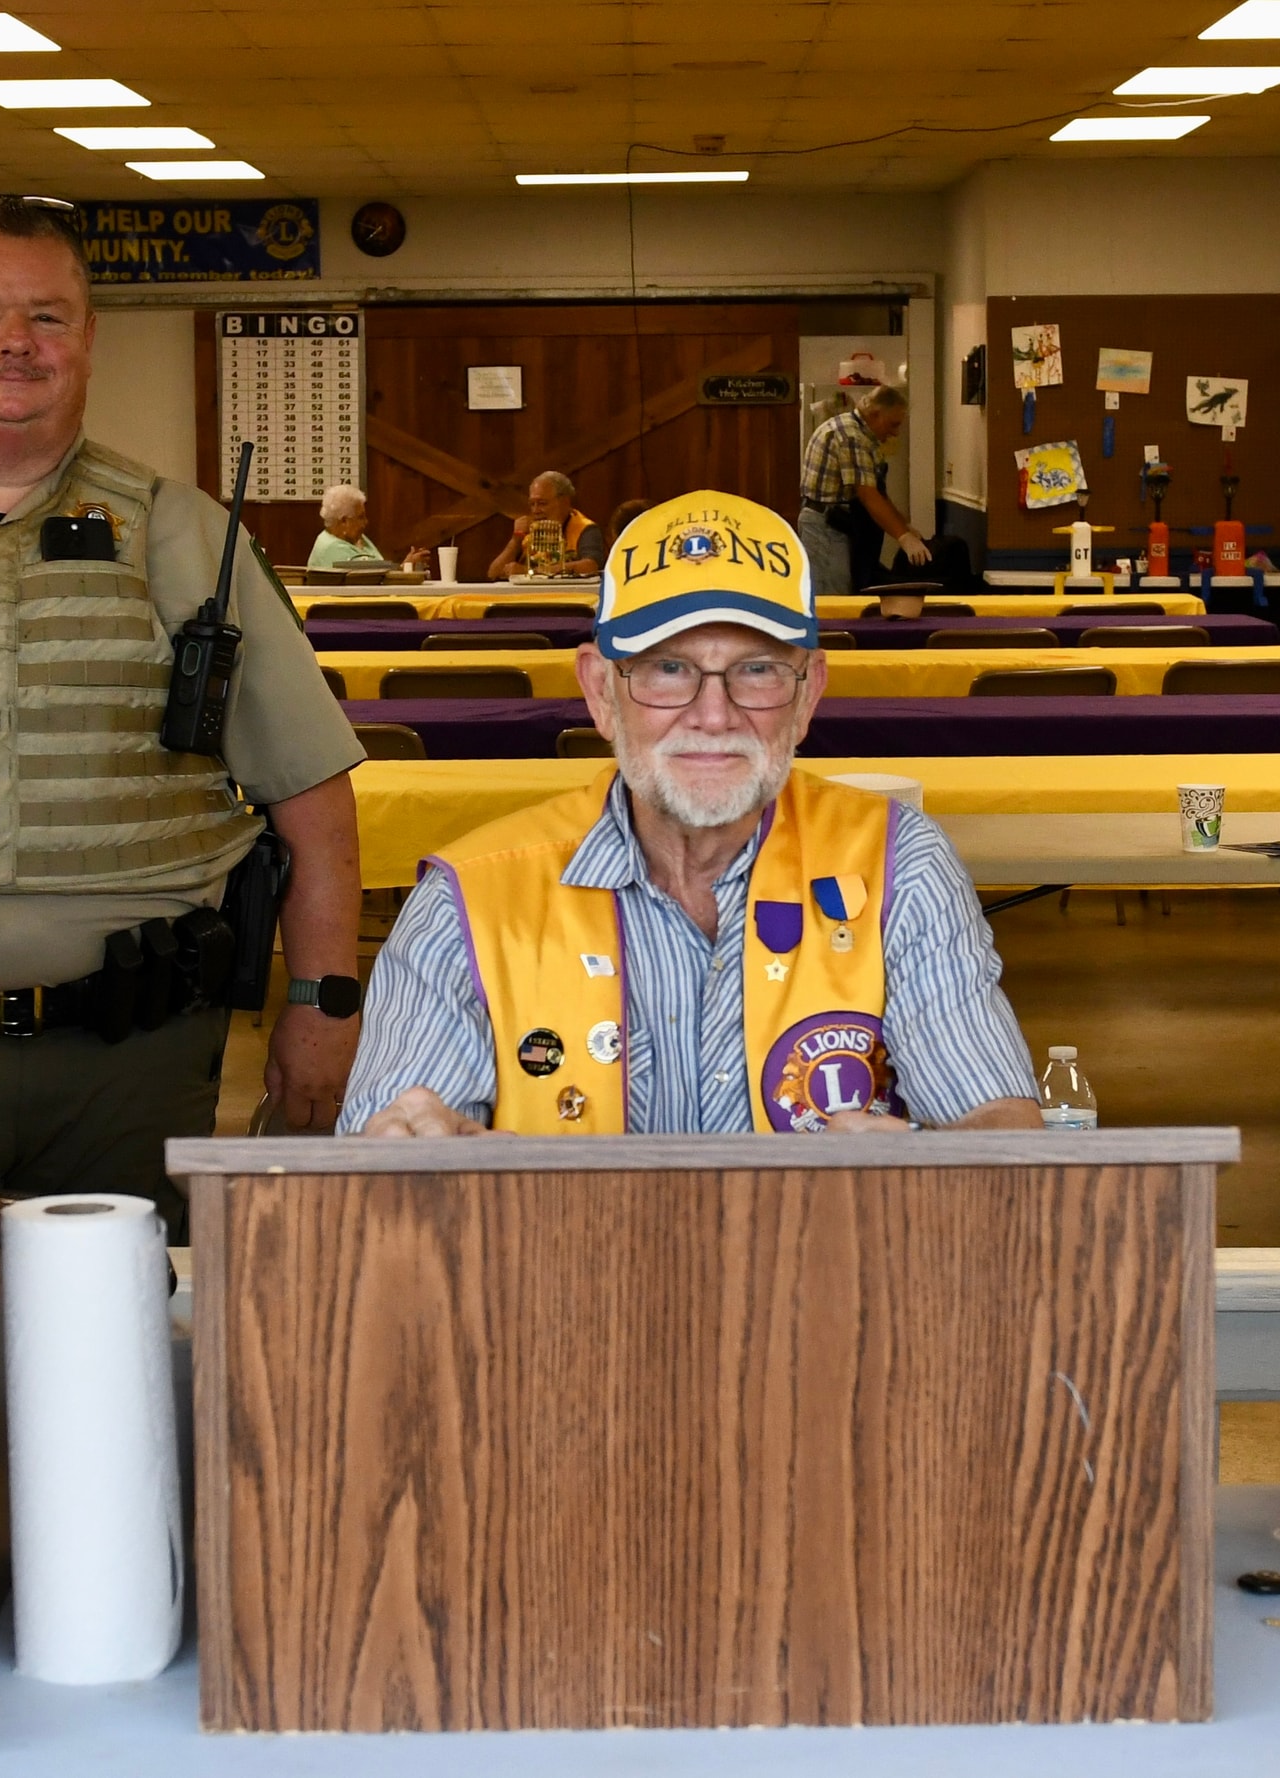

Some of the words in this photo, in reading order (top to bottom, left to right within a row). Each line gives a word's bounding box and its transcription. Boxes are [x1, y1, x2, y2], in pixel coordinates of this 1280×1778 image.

[96, 208, 165, 233] HELP
[172, 208, 233, 234] OUR
[81, 238, 191, 263] MUNITY.
[90, 270, 134, 282] ome
[158, 268, 243, 281] member
[249, 267, 315, 282] today!
[256, 339, 268, 347] 16
[284, 339, 296, 347] 31
[311, 339, 323, 347] 46
[339, 339, 351, 347] 61
[256, 360, 268, 368] 18
[284, 360, 296, 368] 33
[311, 360, 323, 368] 48
[339, 360, 351, 368] 63
[256, 371, 268, 379] 19
[284, 371, 296, 379] 34
[311, 371, 323, 379] 49
[339, 371, 351, 379] 64
[256, 392, 268, 400] 21
[284, 392, 296, 400] 36
[311, 392, 323, 400] 51
[339, 392, 351, 400] 66
[256, 403, 268, 411] 22
[284, 403, 296, 411] 37
[311, 403, 323, 411] 52
[339, 403, 351, 411] 67
[256, 414, 268, 422] 23
[284, 414, 296, 422] 38
[311, 414, 323, 422] 53
[339, 414, 351, 422] 68
[257, 435, 269, 443] 25
[285, 435, 297, 443] 40
[312, 435, 324, 443] 55
[339, 435, 352, 443] 70
[257, 446, 269, 454] 26
[285, 446, 297, 454] 41
[312, 446, 324, 454] 56
[339, 446, 352, 454] 71
[257, 456, 269, 464] 27
[285, 456, 297, 464] 42
[312, 456, 324, 464] 57
[339, 456, 352, 464] 72
[257, 467, 269, 475] 28
[285, 467, 297, 475] 43
[312, 467, 324, 475] 58
[339, 467, 352, 475] 73
[257, 488, 269, 496] 30
[285, 488, 297, 496] 45
[312, 488, 324, 496] 60
[665, 509, 742, 534] ELLIJAY
[1074, 547, 1090, 561] GT
[800, 1030, 871, 1060] LIONS
[818, 1062, 862, 1114] L
